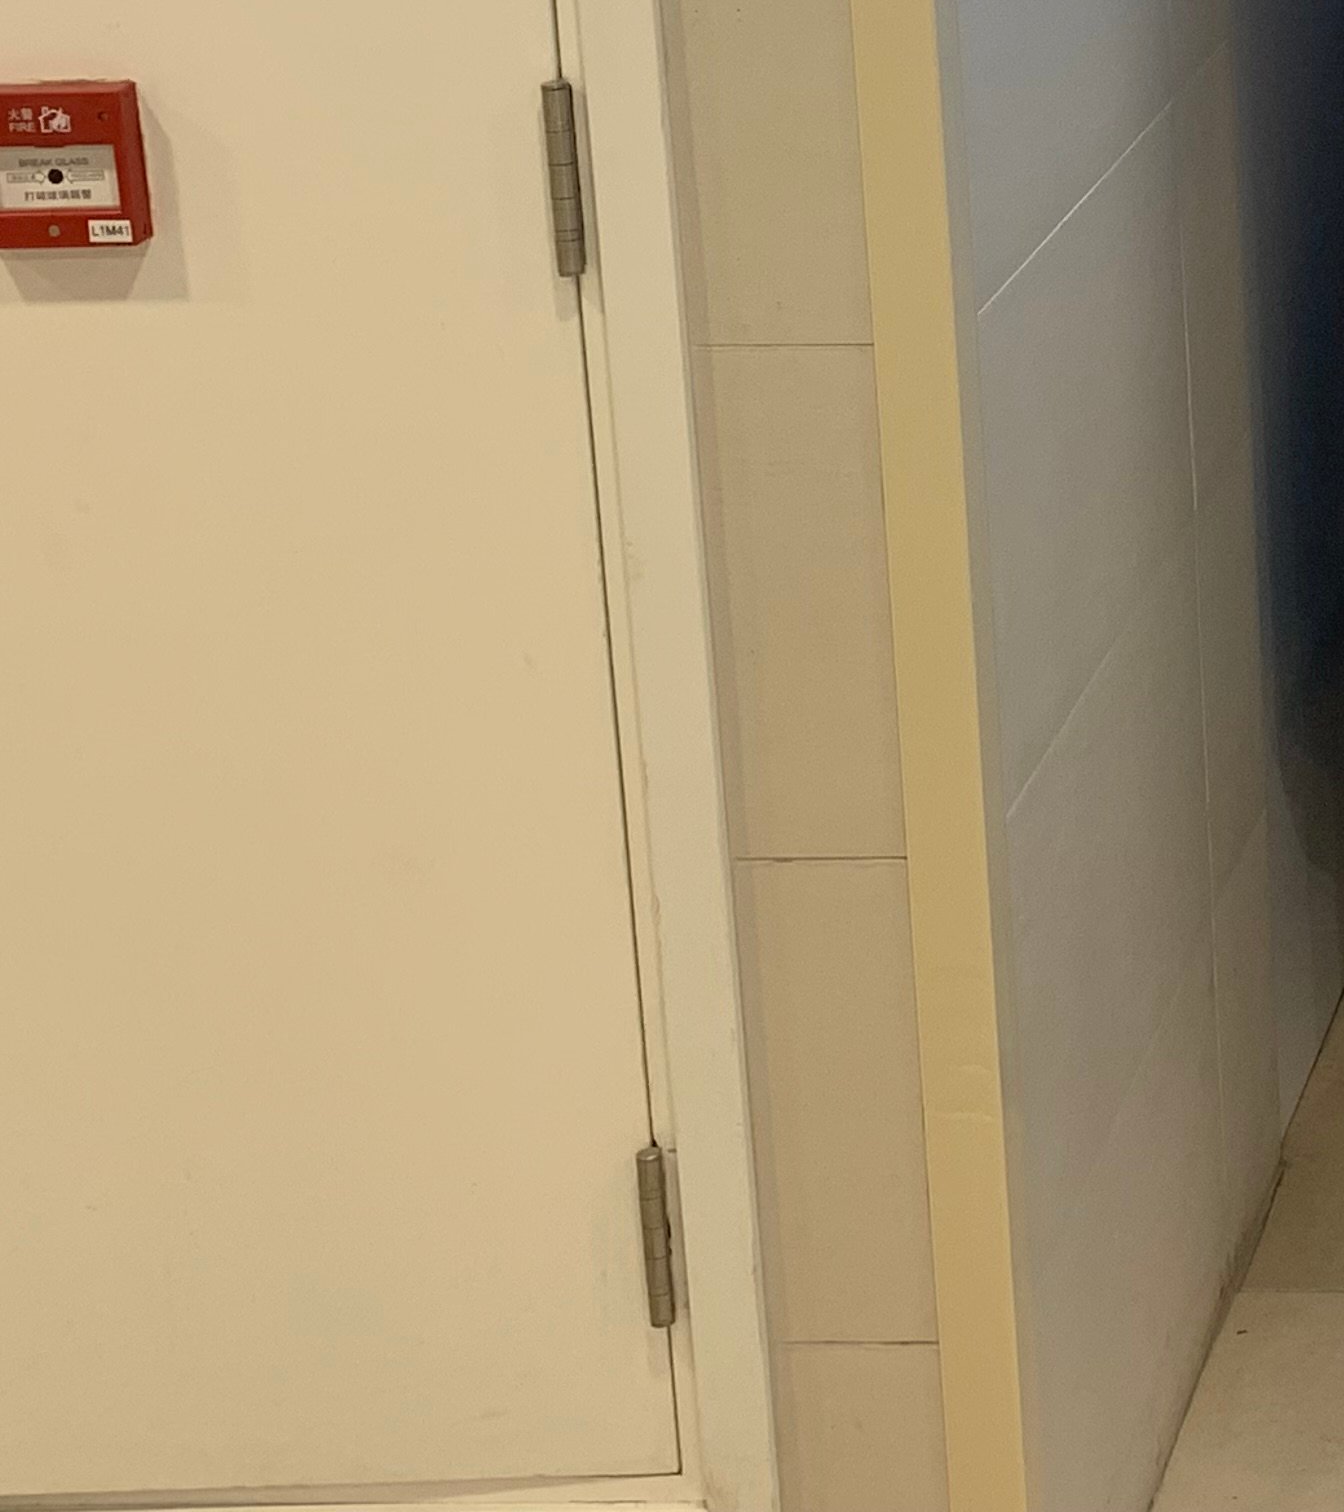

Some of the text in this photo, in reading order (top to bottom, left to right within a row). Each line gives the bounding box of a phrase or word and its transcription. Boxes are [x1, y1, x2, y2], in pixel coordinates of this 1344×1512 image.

[8, 106, 33, 121] 火警
[8, 122, 36, 133] FIRE
[19, 157, 89, 168] BREAK GLASS
